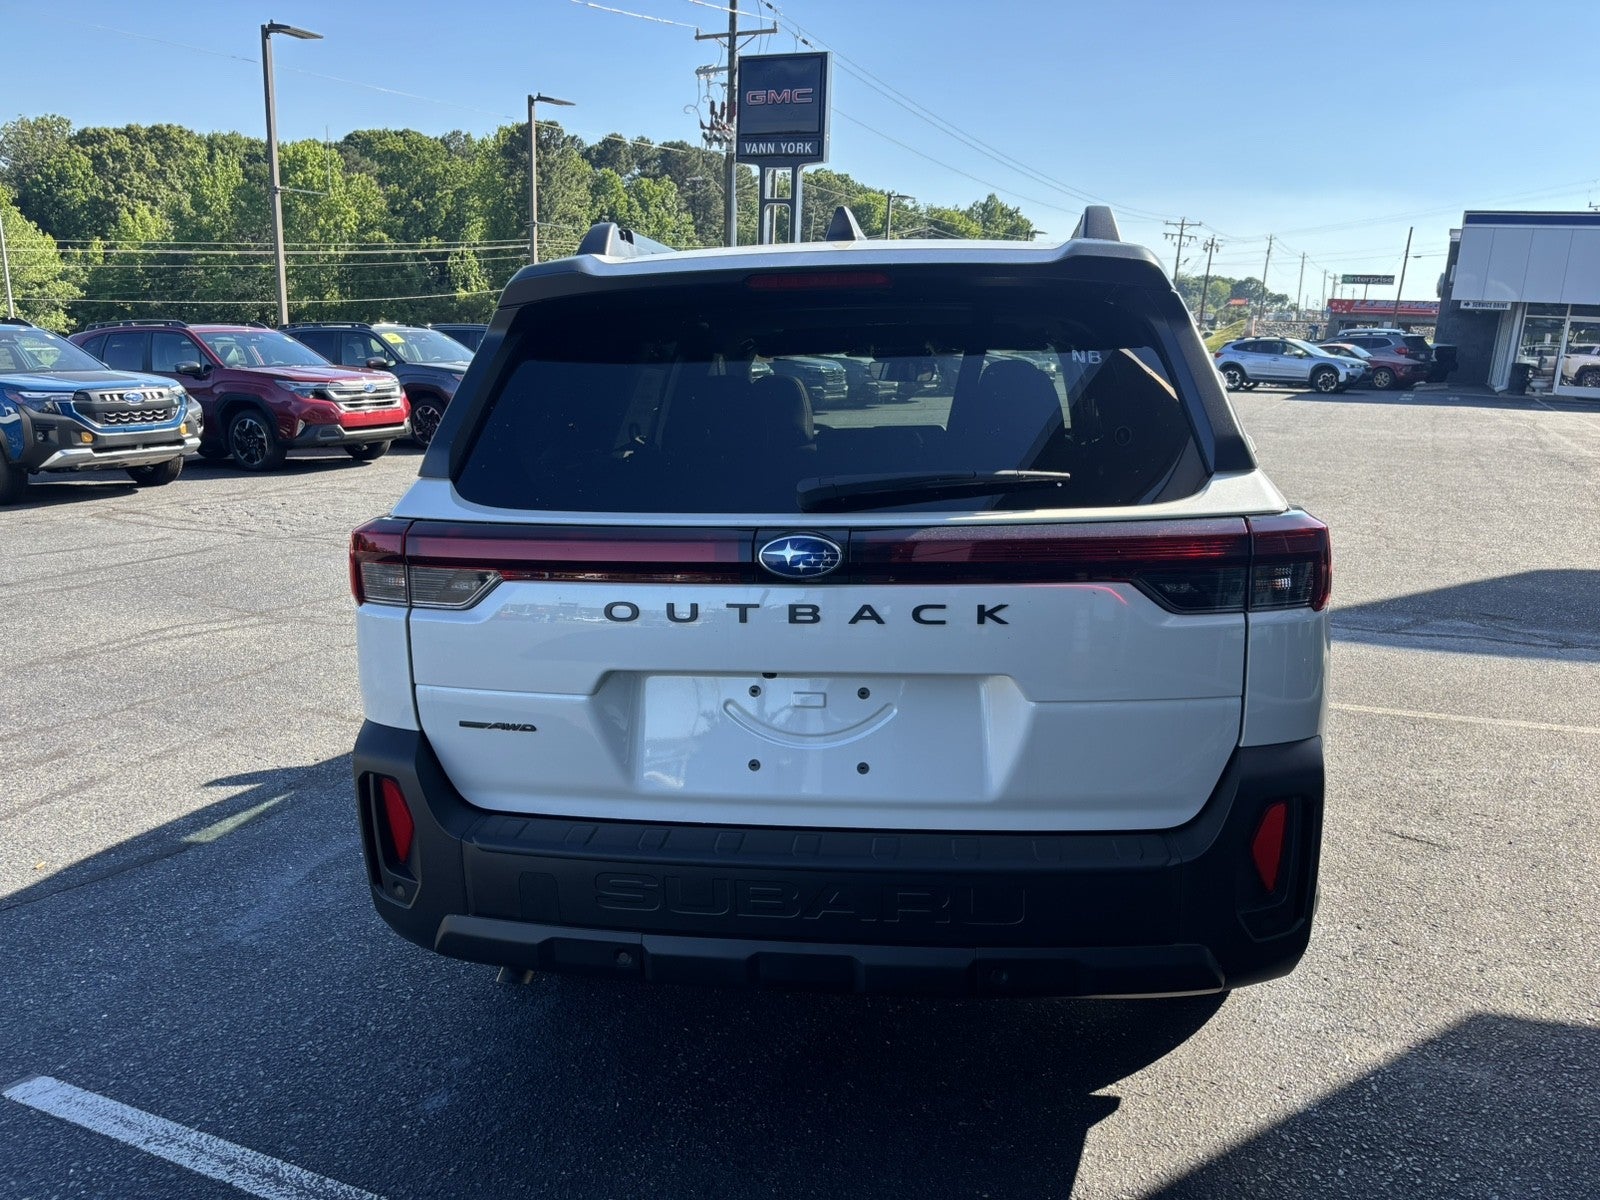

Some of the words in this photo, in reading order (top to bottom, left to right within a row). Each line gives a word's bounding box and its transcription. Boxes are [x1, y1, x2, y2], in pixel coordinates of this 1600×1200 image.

[746, 88, 813, 105] GMC
[745, 143, 775, 153] VANN
[780, 142, 812, 154] YORK
[1071, 350, 1103, 364] NB
[603, 601, 1009, 625] OUTBACK
[594, 872, 1026, 925] SUBARU
